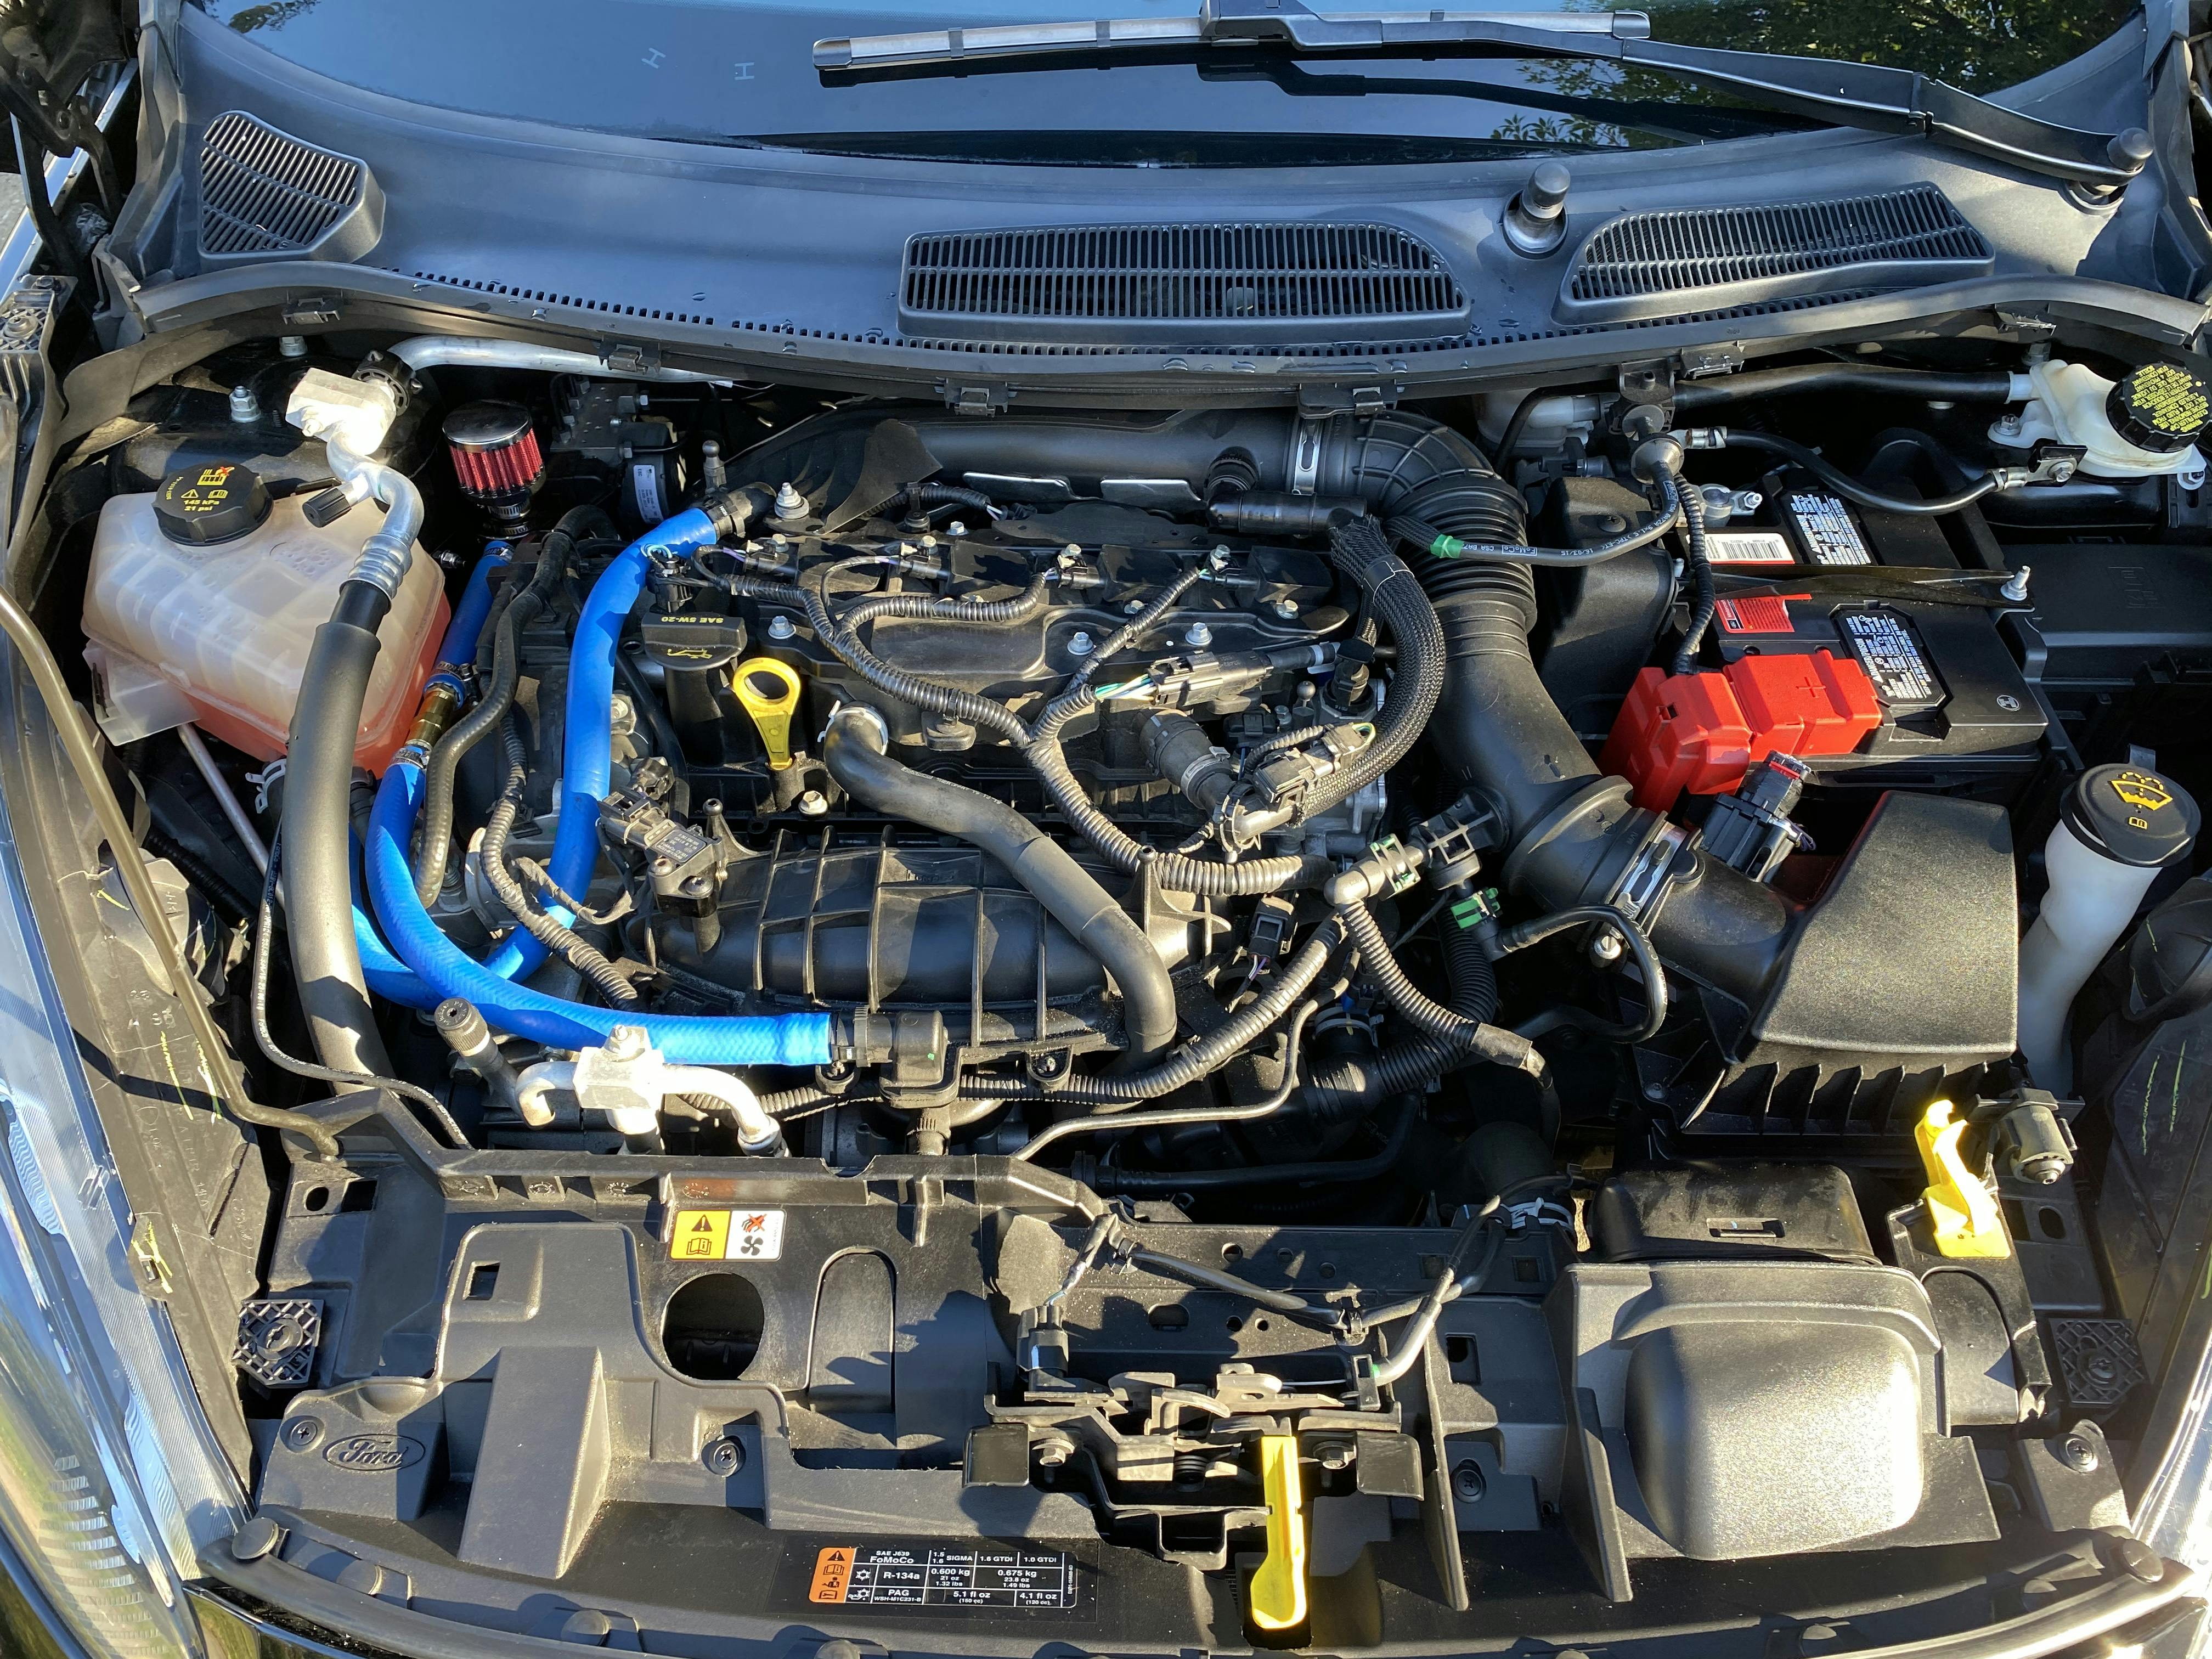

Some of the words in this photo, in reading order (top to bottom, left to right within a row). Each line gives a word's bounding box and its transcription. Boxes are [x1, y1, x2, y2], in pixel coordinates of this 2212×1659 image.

[1632, 523, 1653, 537] 9x1.5
[1502, 545, 1536, 554] FoMoCo
[1854, 639, 1879, 677] DANGER/POISON
[338, 1438, 409, 1464] Ford
[883, 1572, 920, 1580] R-134a
[957, 1569, 970, 1577] kg
[1024, 1570, 1037, 1578] kg
